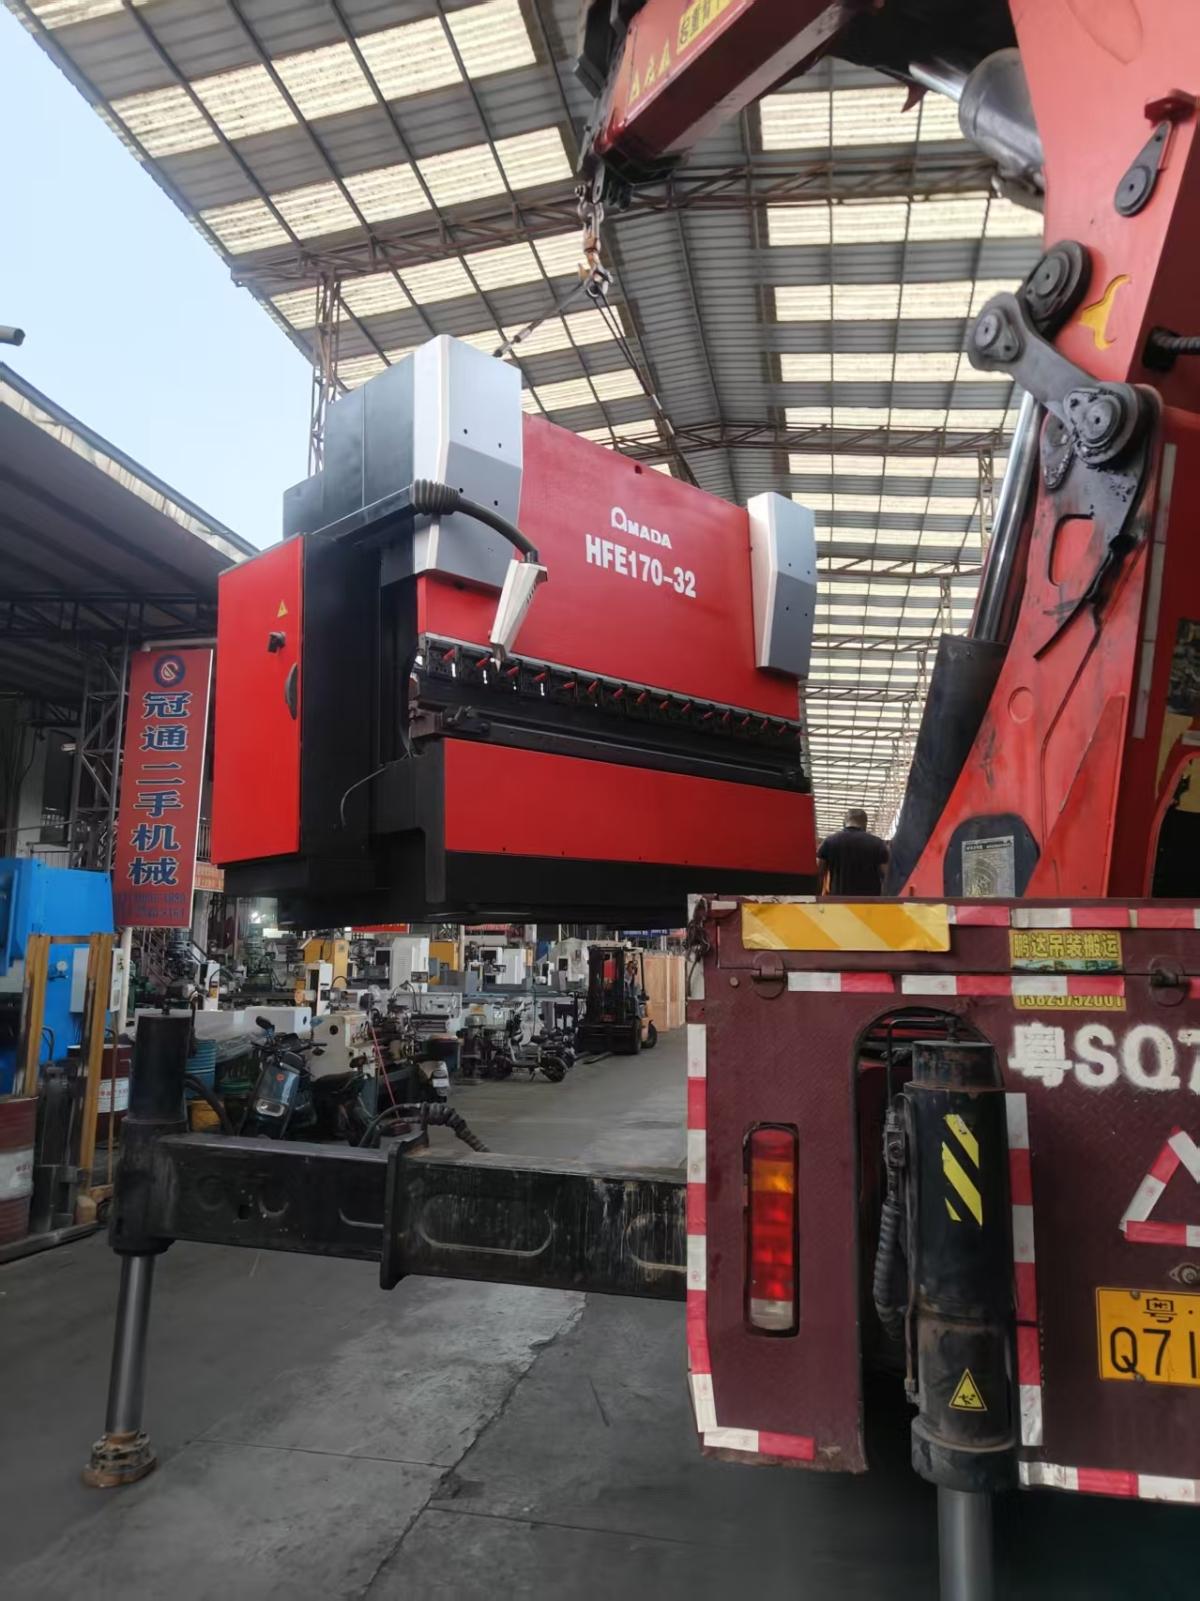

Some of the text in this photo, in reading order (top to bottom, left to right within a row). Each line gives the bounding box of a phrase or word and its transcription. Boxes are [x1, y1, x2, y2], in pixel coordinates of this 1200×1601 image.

[585, 533, 697, 599] HFE170-32
[128, 690, 192, 887] 冠通二手机械
[1013, 934, 1119, 958] 鹏达吊装搬运
